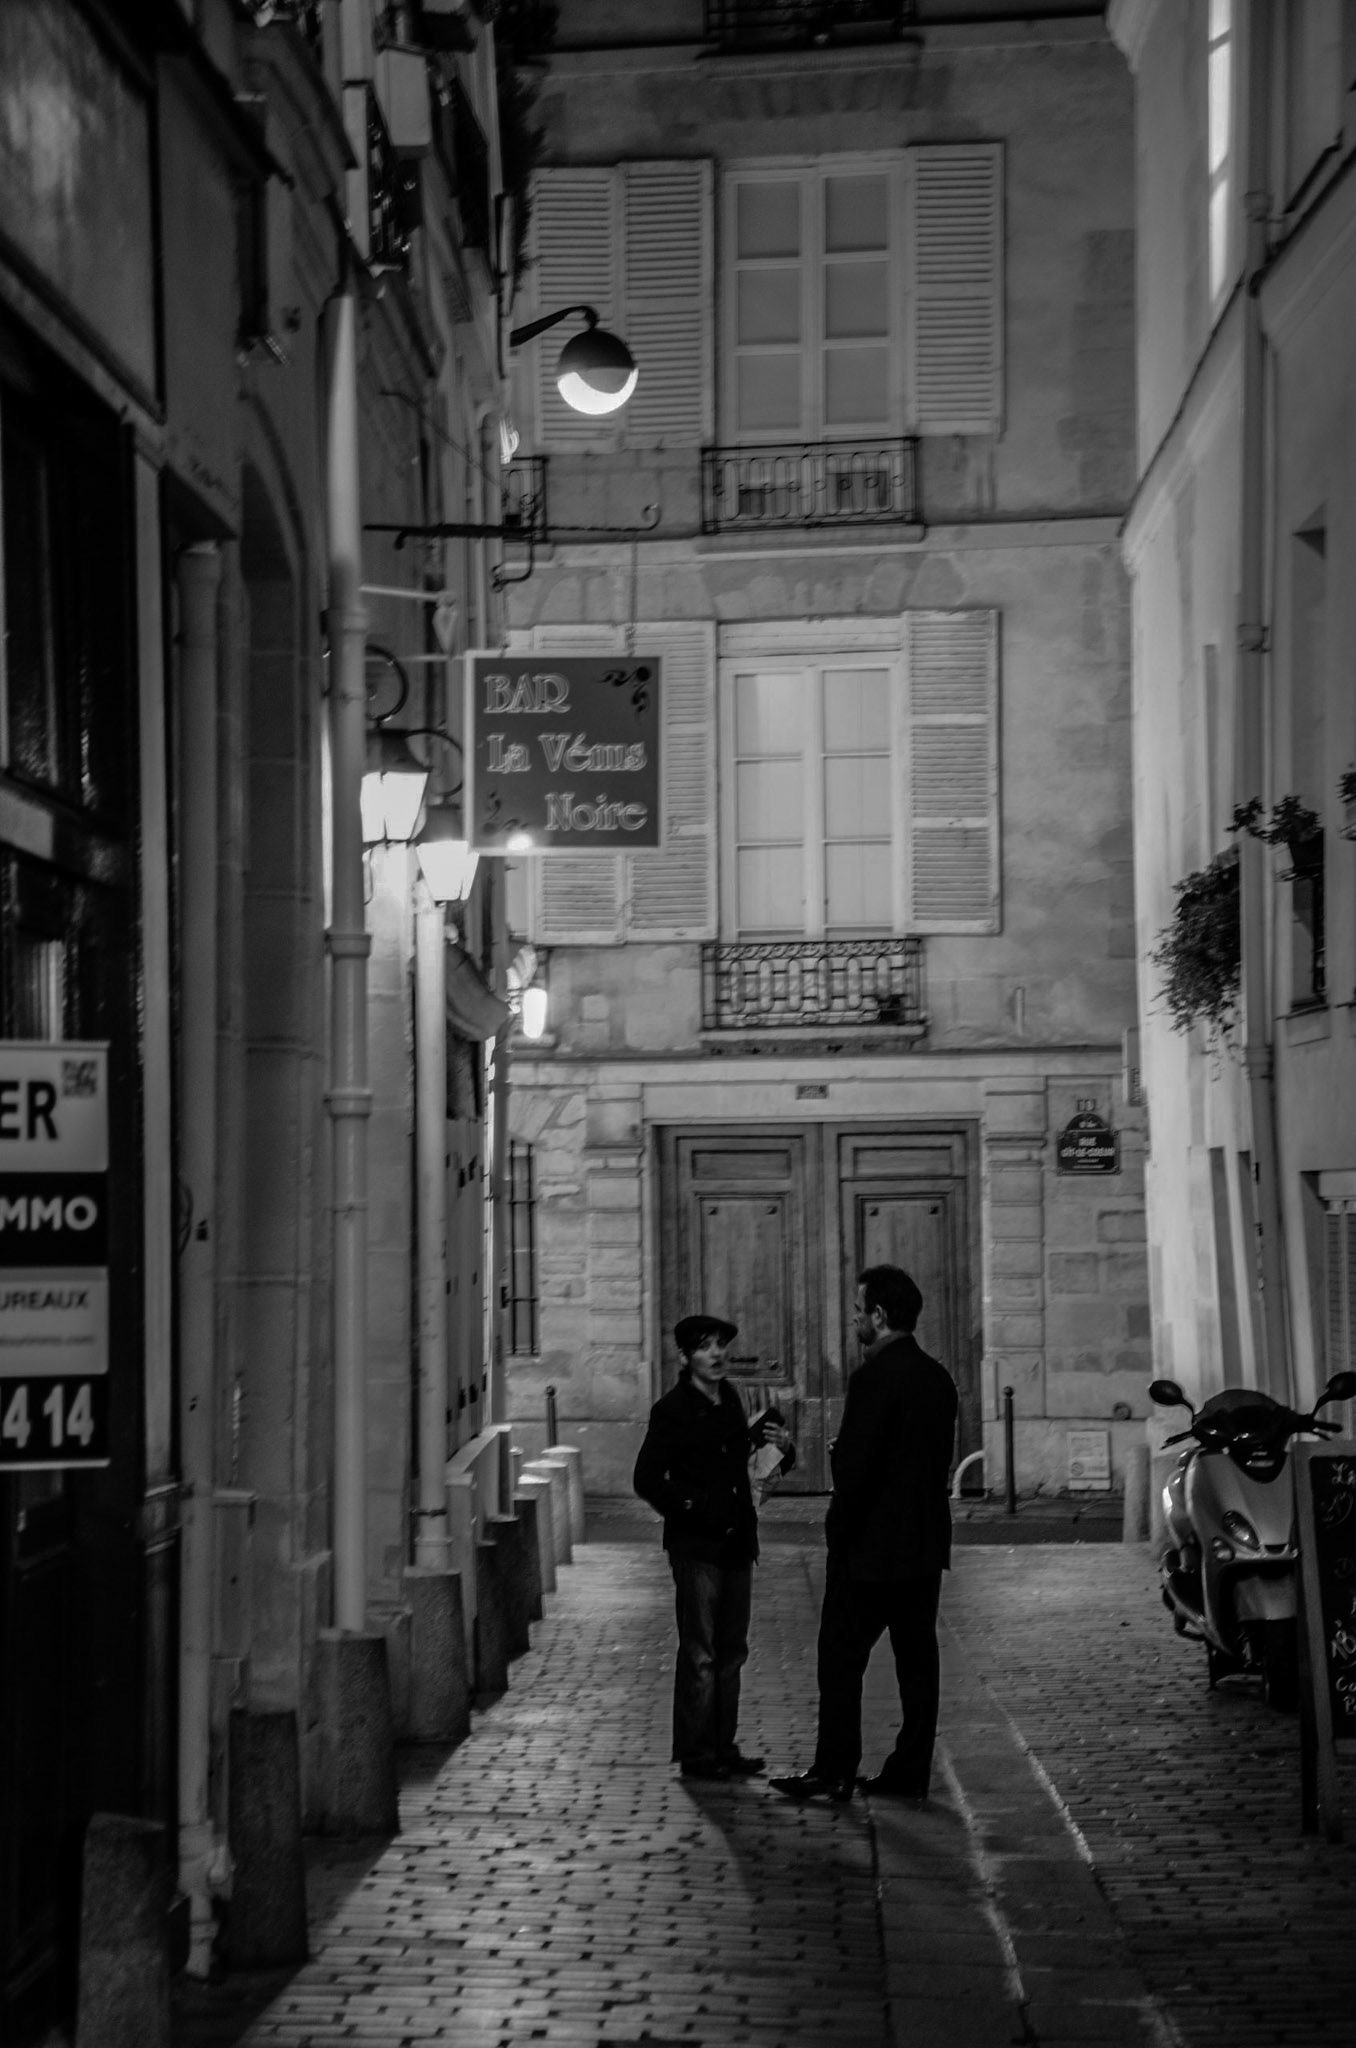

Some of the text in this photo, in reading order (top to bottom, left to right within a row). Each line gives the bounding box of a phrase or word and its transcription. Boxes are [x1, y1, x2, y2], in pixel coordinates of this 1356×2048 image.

[484, 673, 571, 713] BAR
[487, 732, 647, 774] La Vénus
[545, 793, 648, 831] Noire
[0, 1081, 57, 1139] ER
